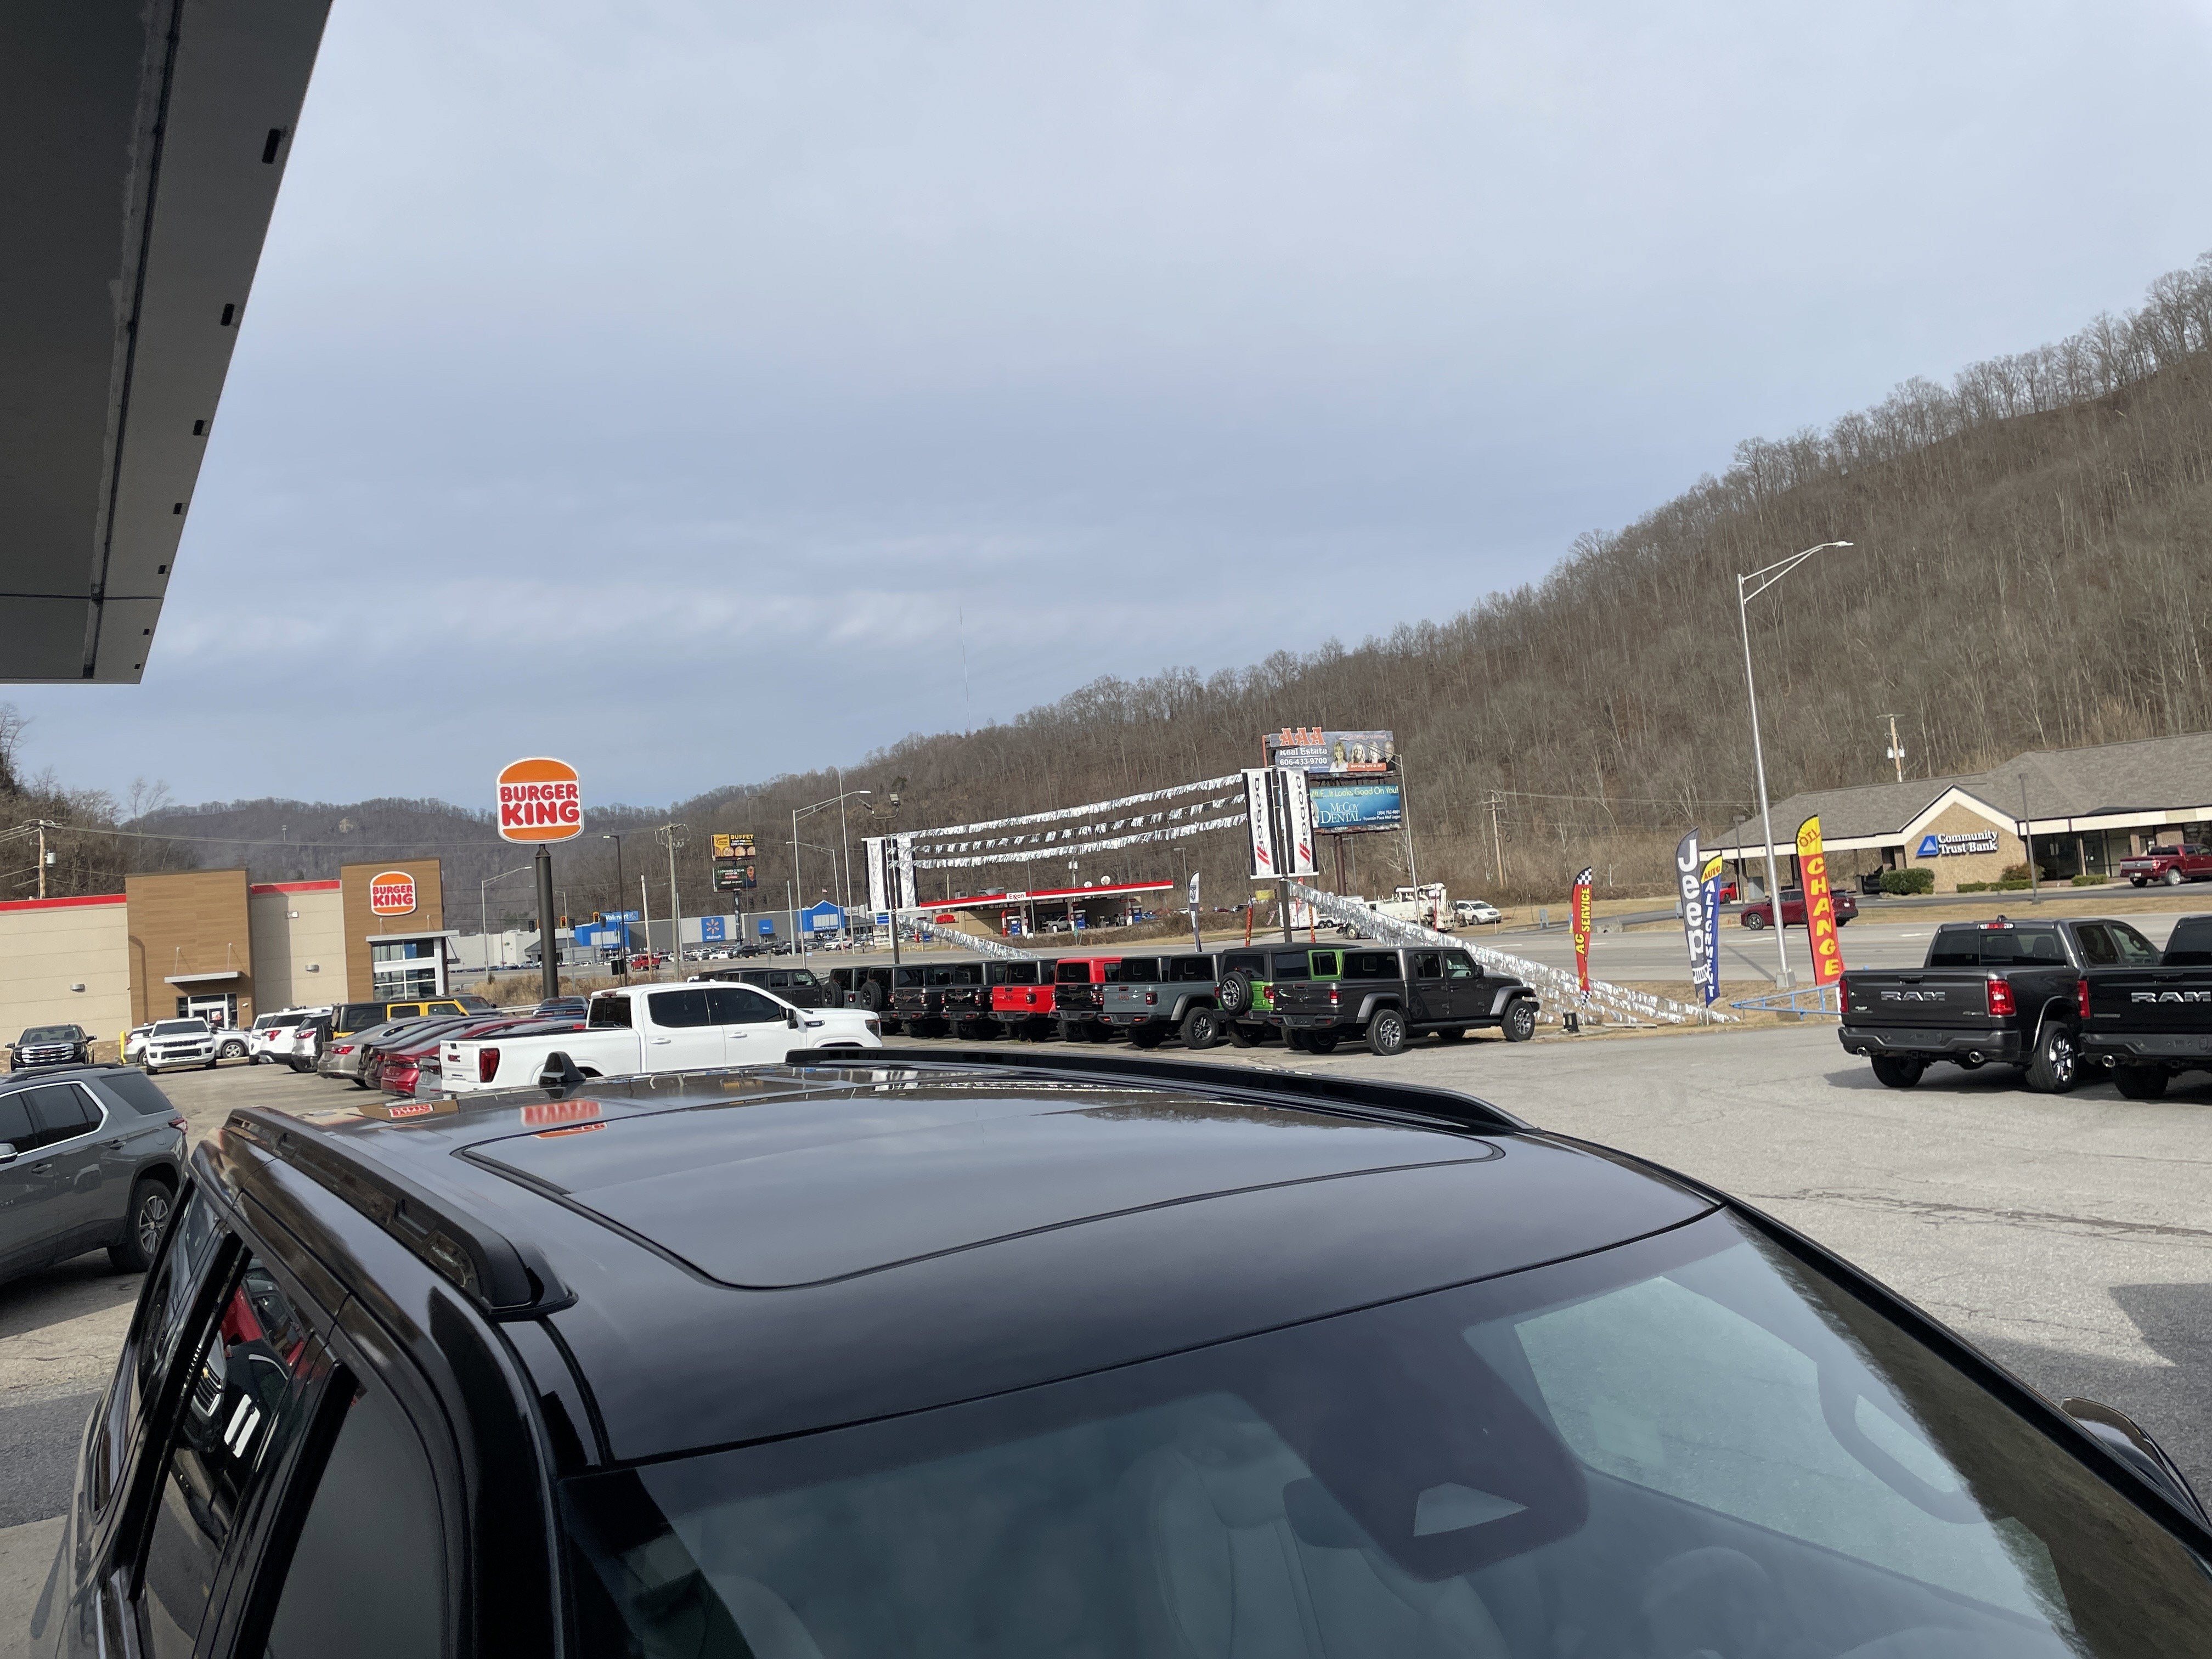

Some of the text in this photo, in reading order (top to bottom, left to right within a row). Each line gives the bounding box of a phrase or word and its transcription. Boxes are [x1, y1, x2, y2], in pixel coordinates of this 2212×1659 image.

[1279, 727, 1326, 746] AAA
[1279, 747, 1328, 756] Real Estate
[1279, 757, 1328, 766] 606-433-9700
[500, 783, 579, 803] BURGER
[1354, 787, 1373, 795] Good
[1374, 787, 1384, 795] On
[1386, 786, 1399, 794] You!
[501, 800, 580, 827] KING
[1255, 777, 1266, 851] DODGE
[1296, 776, 1307, 851] DODGE
[1320, 810, 1362, 824] DENTAL
[1799, 828, 1821, 848] OIL
[1938, 829, 1998, 843] Community
[1939, 840, 1997, 854] Trust Bank
[1704, 865, 1721, 881] AUTO
[373, 885, 413, 895] BURGER
[373, 893, 414, 906] KING
[1678, 838, 1703, 961] Jeep
[1575, 887, 1591, 955] AC SERVICE
[1807, 857, 1840, 976] CHANGE
[1881, 991, 1945, 1001] RAM
[2131, 991, 2211, 1003] RAM
